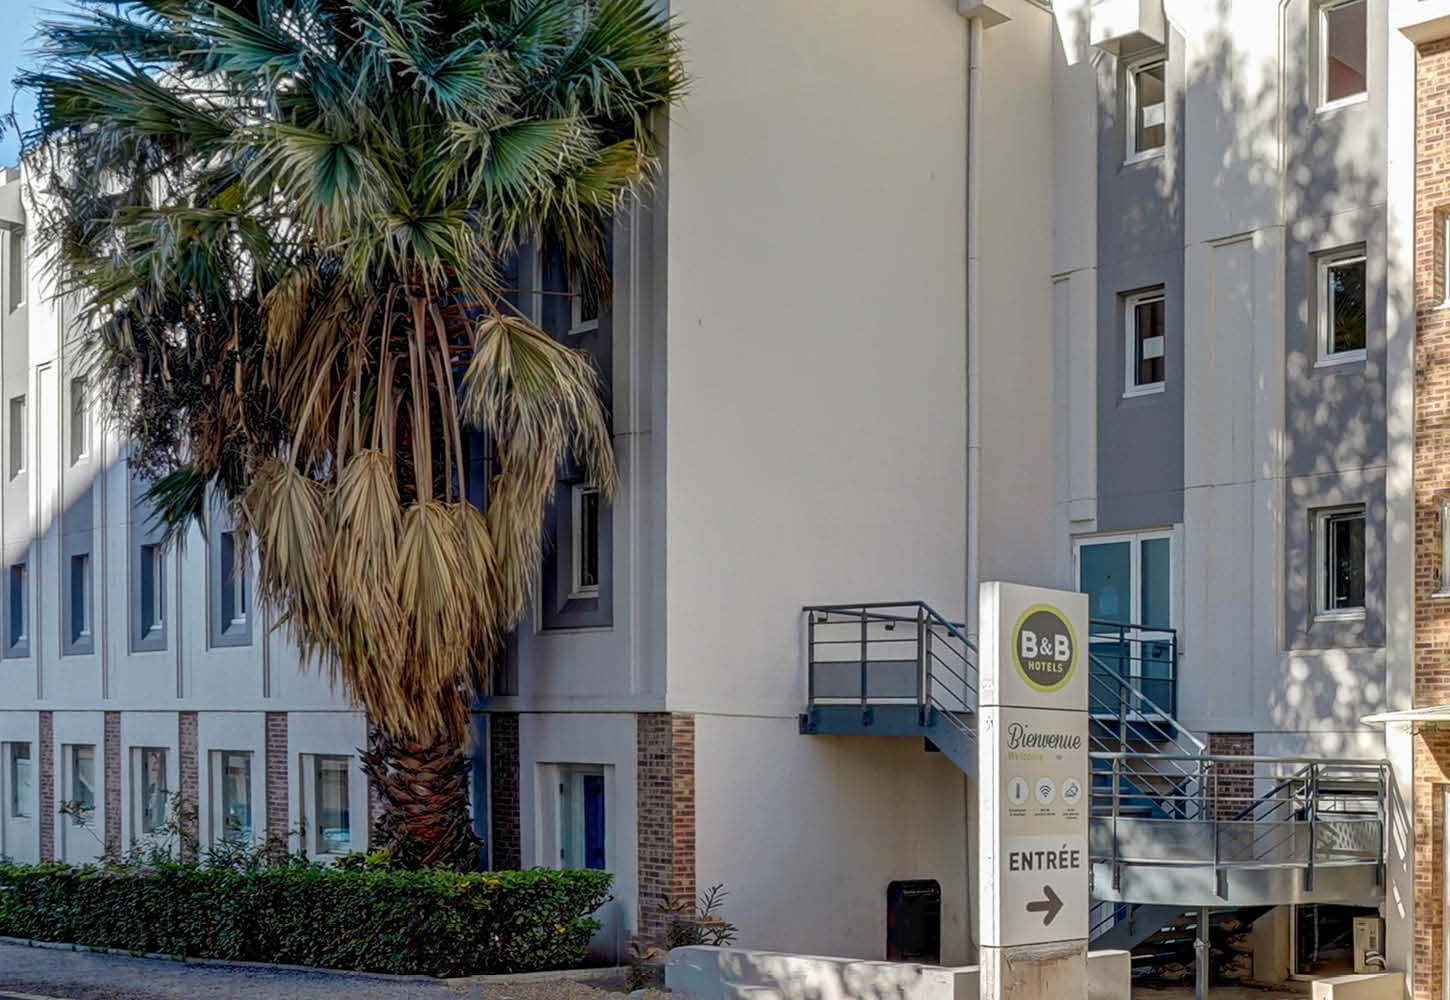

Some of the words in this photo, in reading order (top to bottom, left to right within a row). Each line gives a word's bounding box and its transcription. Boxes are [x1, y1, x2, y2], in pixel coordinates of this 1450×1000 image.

[1021, 629, 1071, 662] B&B
[1028, 660, 1063, 673] HOTELS
[1007, 722, 1082, 750] Bienvenue
[1009, 843, 1080, 871] ENTRÉE
